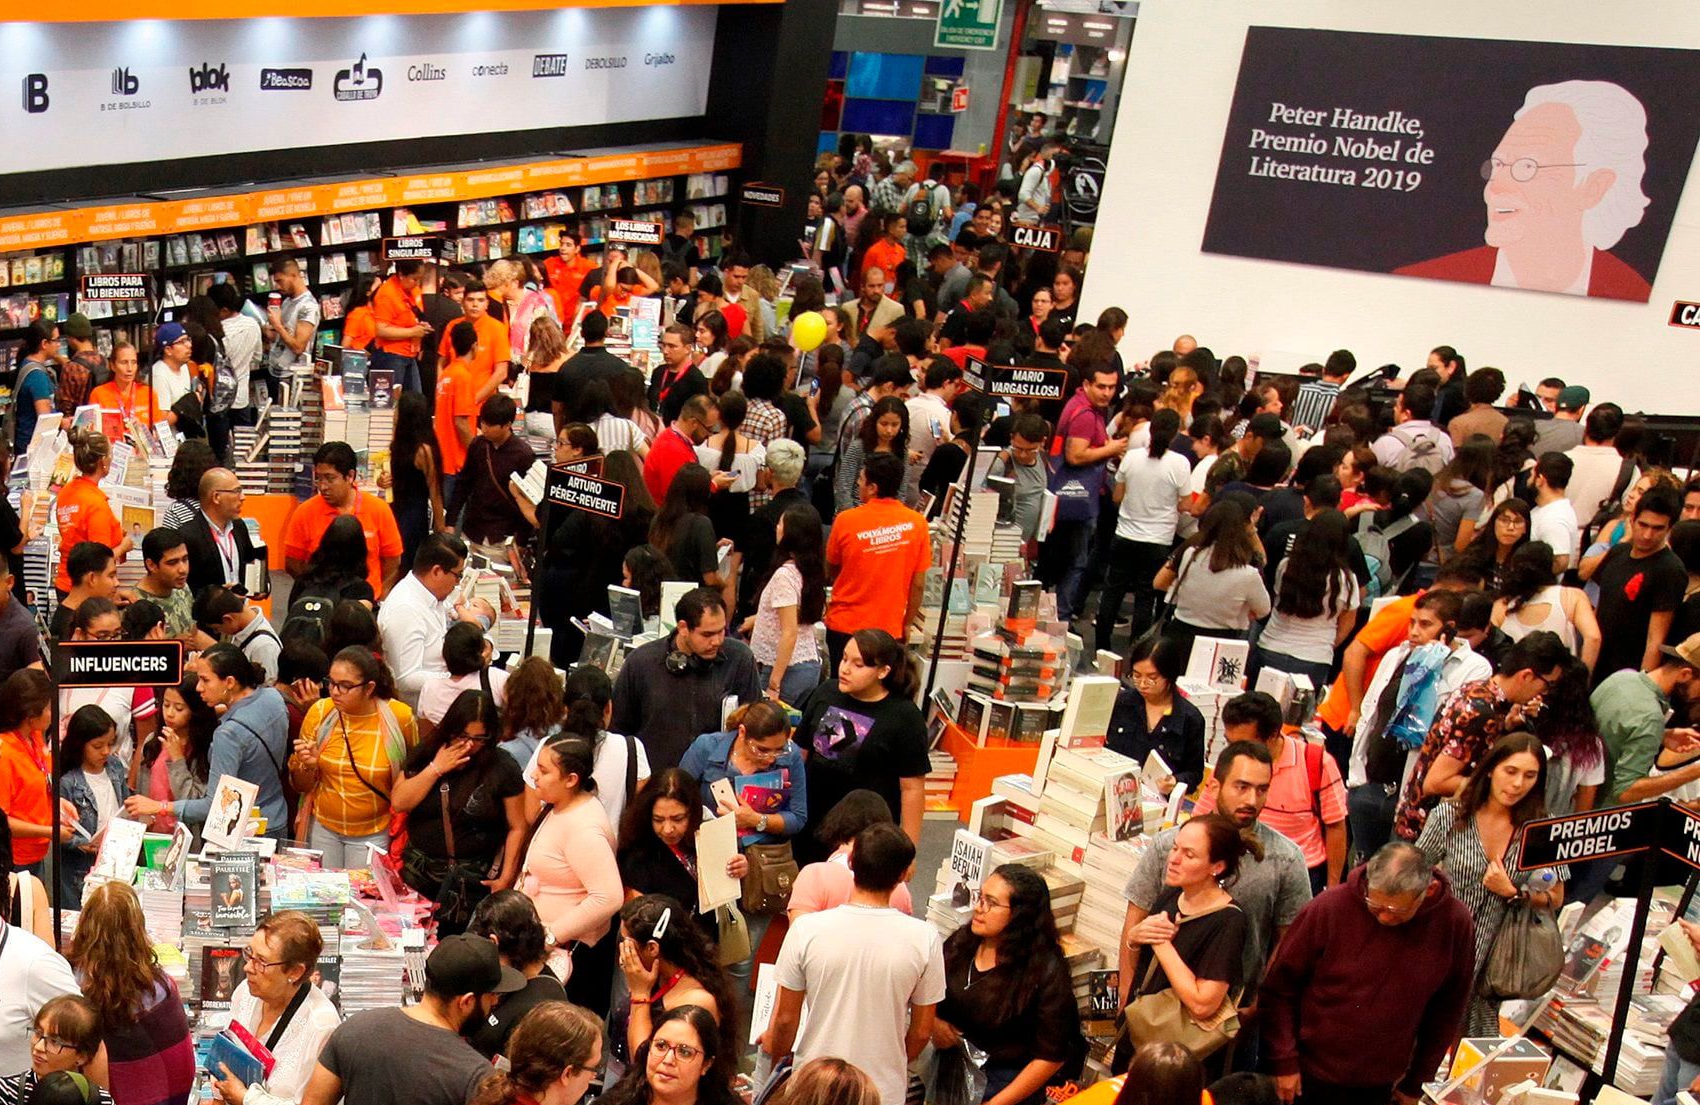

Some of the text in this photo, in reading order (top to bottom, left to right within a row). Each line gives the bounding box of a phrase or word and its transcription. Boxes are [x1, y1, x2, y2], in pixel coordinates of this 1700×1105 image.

[472, 62, 509, 77] conecta
[533, 55, 567, 77] DEBATE
[585, 56, 628, 70] DEBOLSILLO
[644, 52, 675, 68] Grijalbo
[189, 62, 230, 94] blok
[408, 62, 446, 81] Collins
[108, 100, 151, 111] DE BOLSILLO
[1268, 102, 1424, 139] Peter Handke,
[1248, 129, 1435, 165] Premio Nobel de
[1248, 156, 1422, 192] Literatura 2019
[397, 239, 423, 249] LIBROS
[1015, 228, 1051, 249] CAJA
[388, 248, 432, 258] SINGULARES
[89, 276, 143, 287] LIBROS PARA
[87, 287, 146, 299] TU BIENESTAR
[1012, 370, 1044, 383] MARIO
[992, 382, 1060, 397] VARGAS LLOSA
[568, 477, 602, 495] ARTURO
[550, 485, 617, 513] PÉREZ-REVERTE
[70, 655, 168, 674] INFLUENCERS
[1550, 811, 1632, 841] PREMIOS
[955, 840, 982, 866] ISAIAH
[1556, 835, 1616, 860] NOBEL
[952, 855, 980, 881] BERLIN
